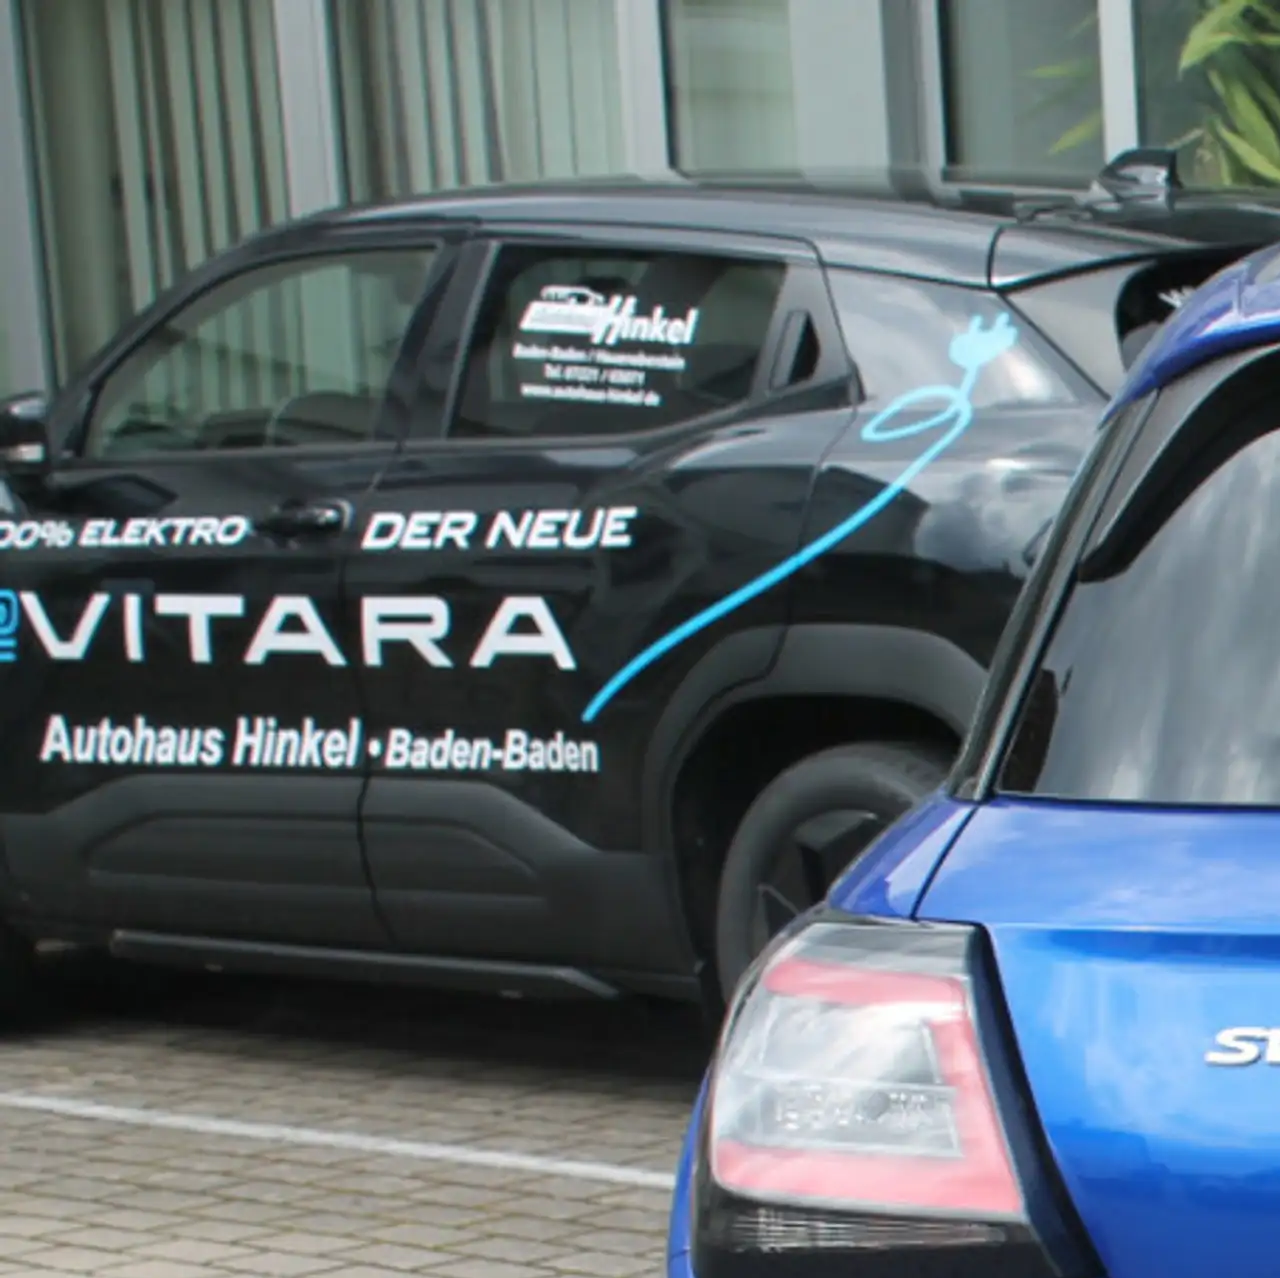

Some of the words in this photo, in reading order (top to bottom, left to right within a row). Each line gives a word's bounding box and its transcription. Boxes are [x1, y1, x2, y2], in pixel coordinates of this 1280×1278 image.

[591, 294, 698, 345] Hinkel
[78, 515, 250, 547] ELEKTRO
[361, 511, 477, 549] DER
[485, 506, 637, 549] NEUE
[40, 714, 224, 766] Autohaus
[233, 716, 361, 768] Hinkel
[385, 728, 599, 772] Baden-Baden
